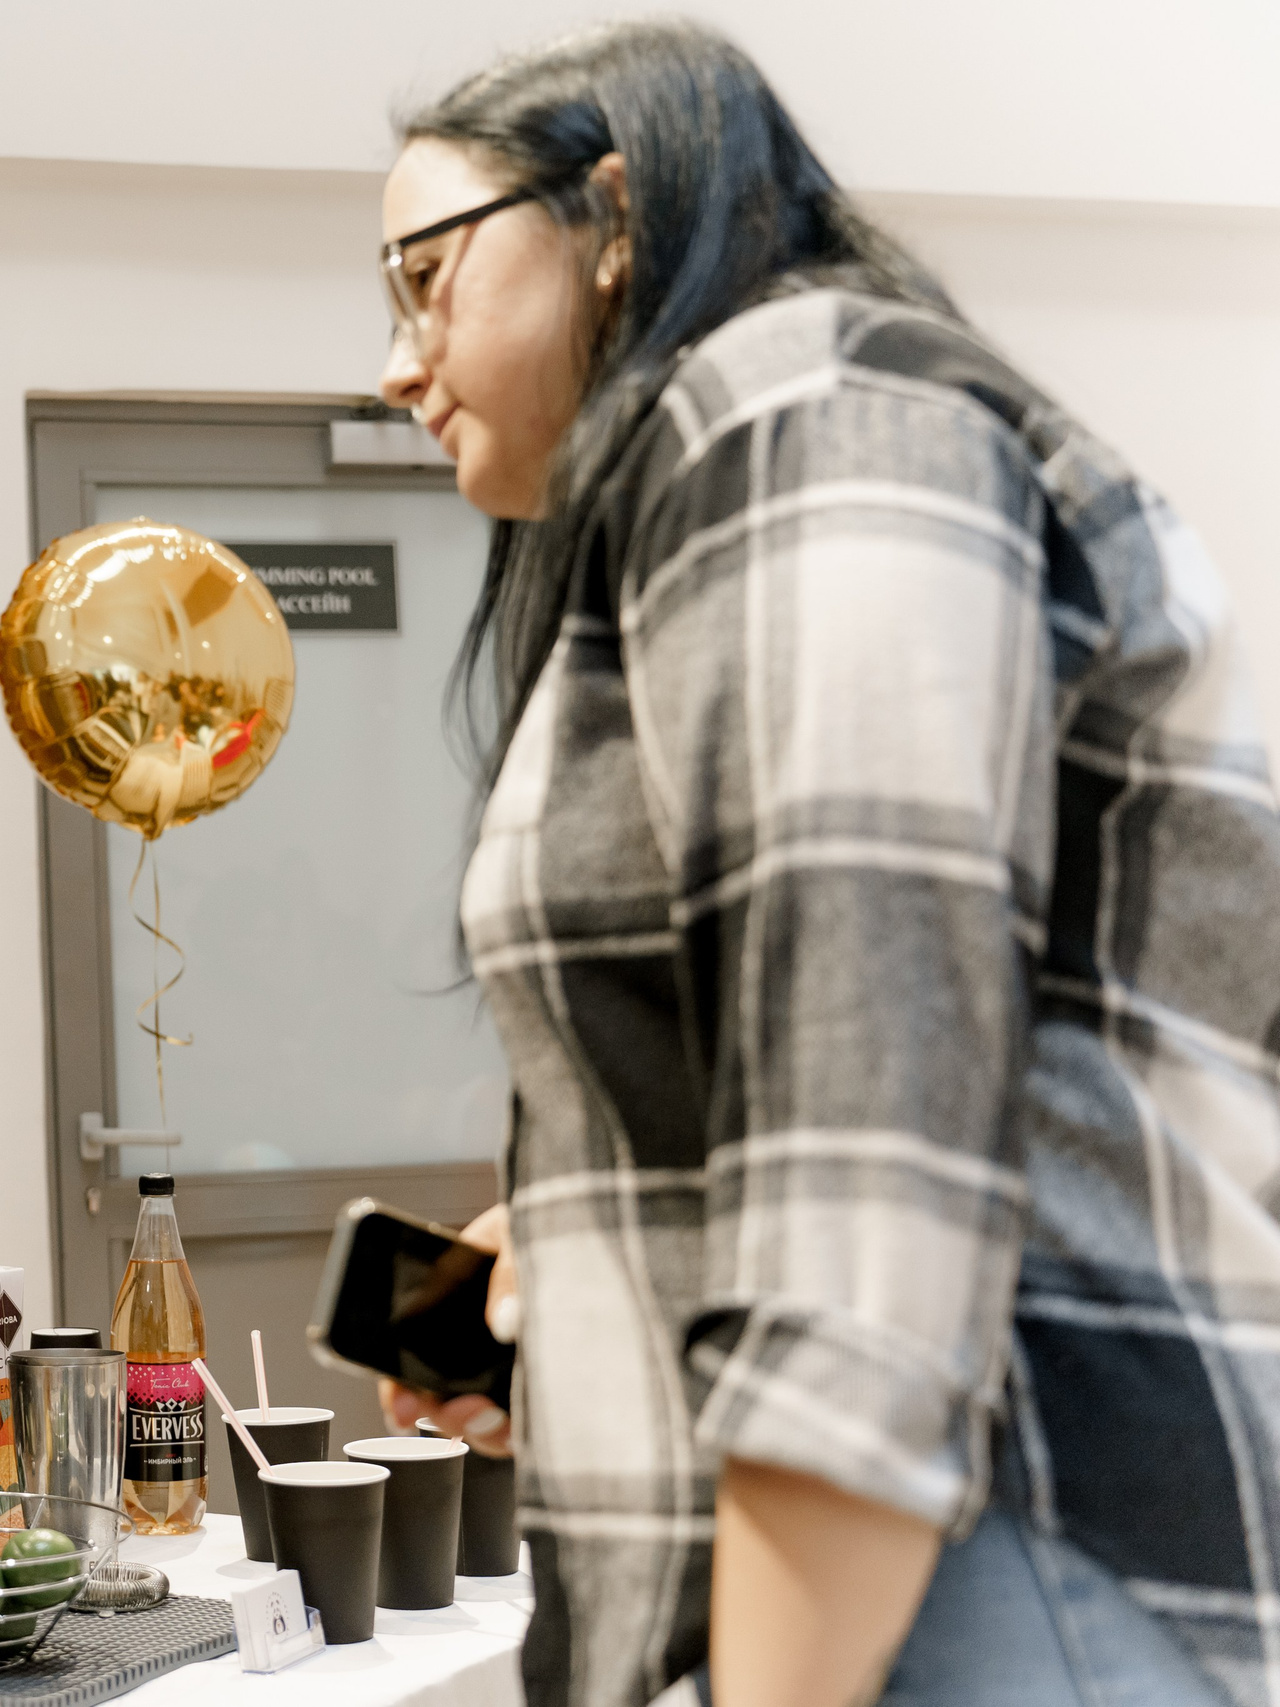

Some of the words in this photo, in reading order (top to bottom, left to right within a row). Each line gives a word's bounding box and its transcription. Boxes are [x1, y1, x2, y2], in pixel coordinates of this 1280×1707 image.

[328, 566, 378, 586] POOL
[151, 1377, 170, 1389] Tonic
[171, 1377, 189, 1389] Club
[132, 1412, 204, 1440] EVERVESS
